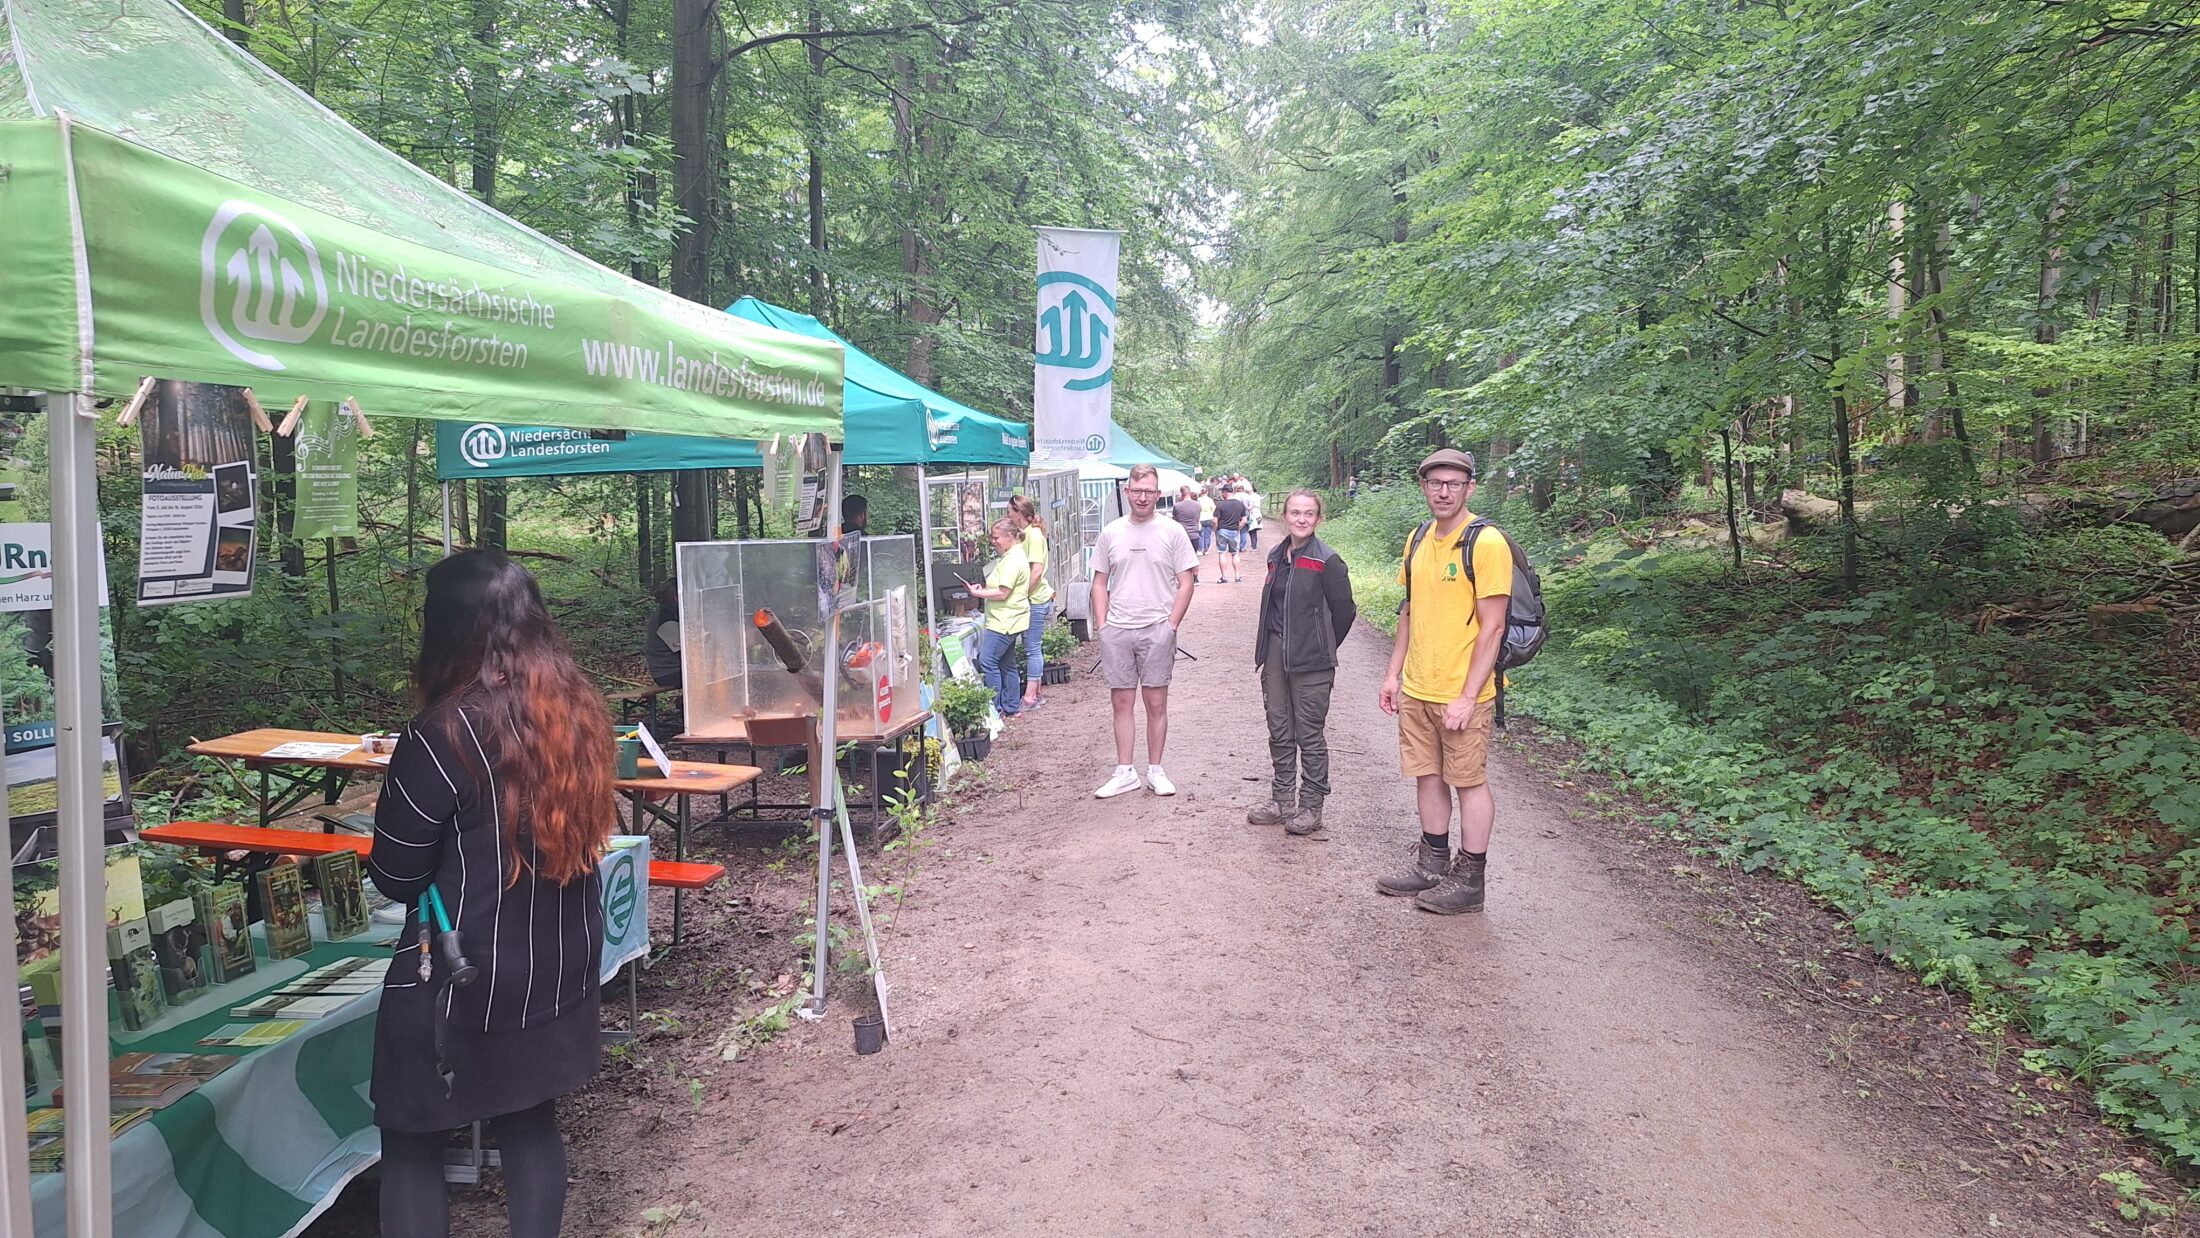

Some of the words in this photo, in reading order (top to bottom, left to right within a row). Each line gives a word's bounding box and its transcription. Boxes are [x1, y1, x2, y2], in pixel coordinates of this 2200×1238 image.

[335, 250, 556, 331] Niedersächsische
[330, 306, 529, 370] Landesforsten
[581, 338, 825, 408] www.landesforsten.de
[511, 442, 610, 458] Landesforsten
[0, 543, 52, 570] Rn
[15, 592, 41, 603] Harz
[12, 726, 55, 743] SOLLI
